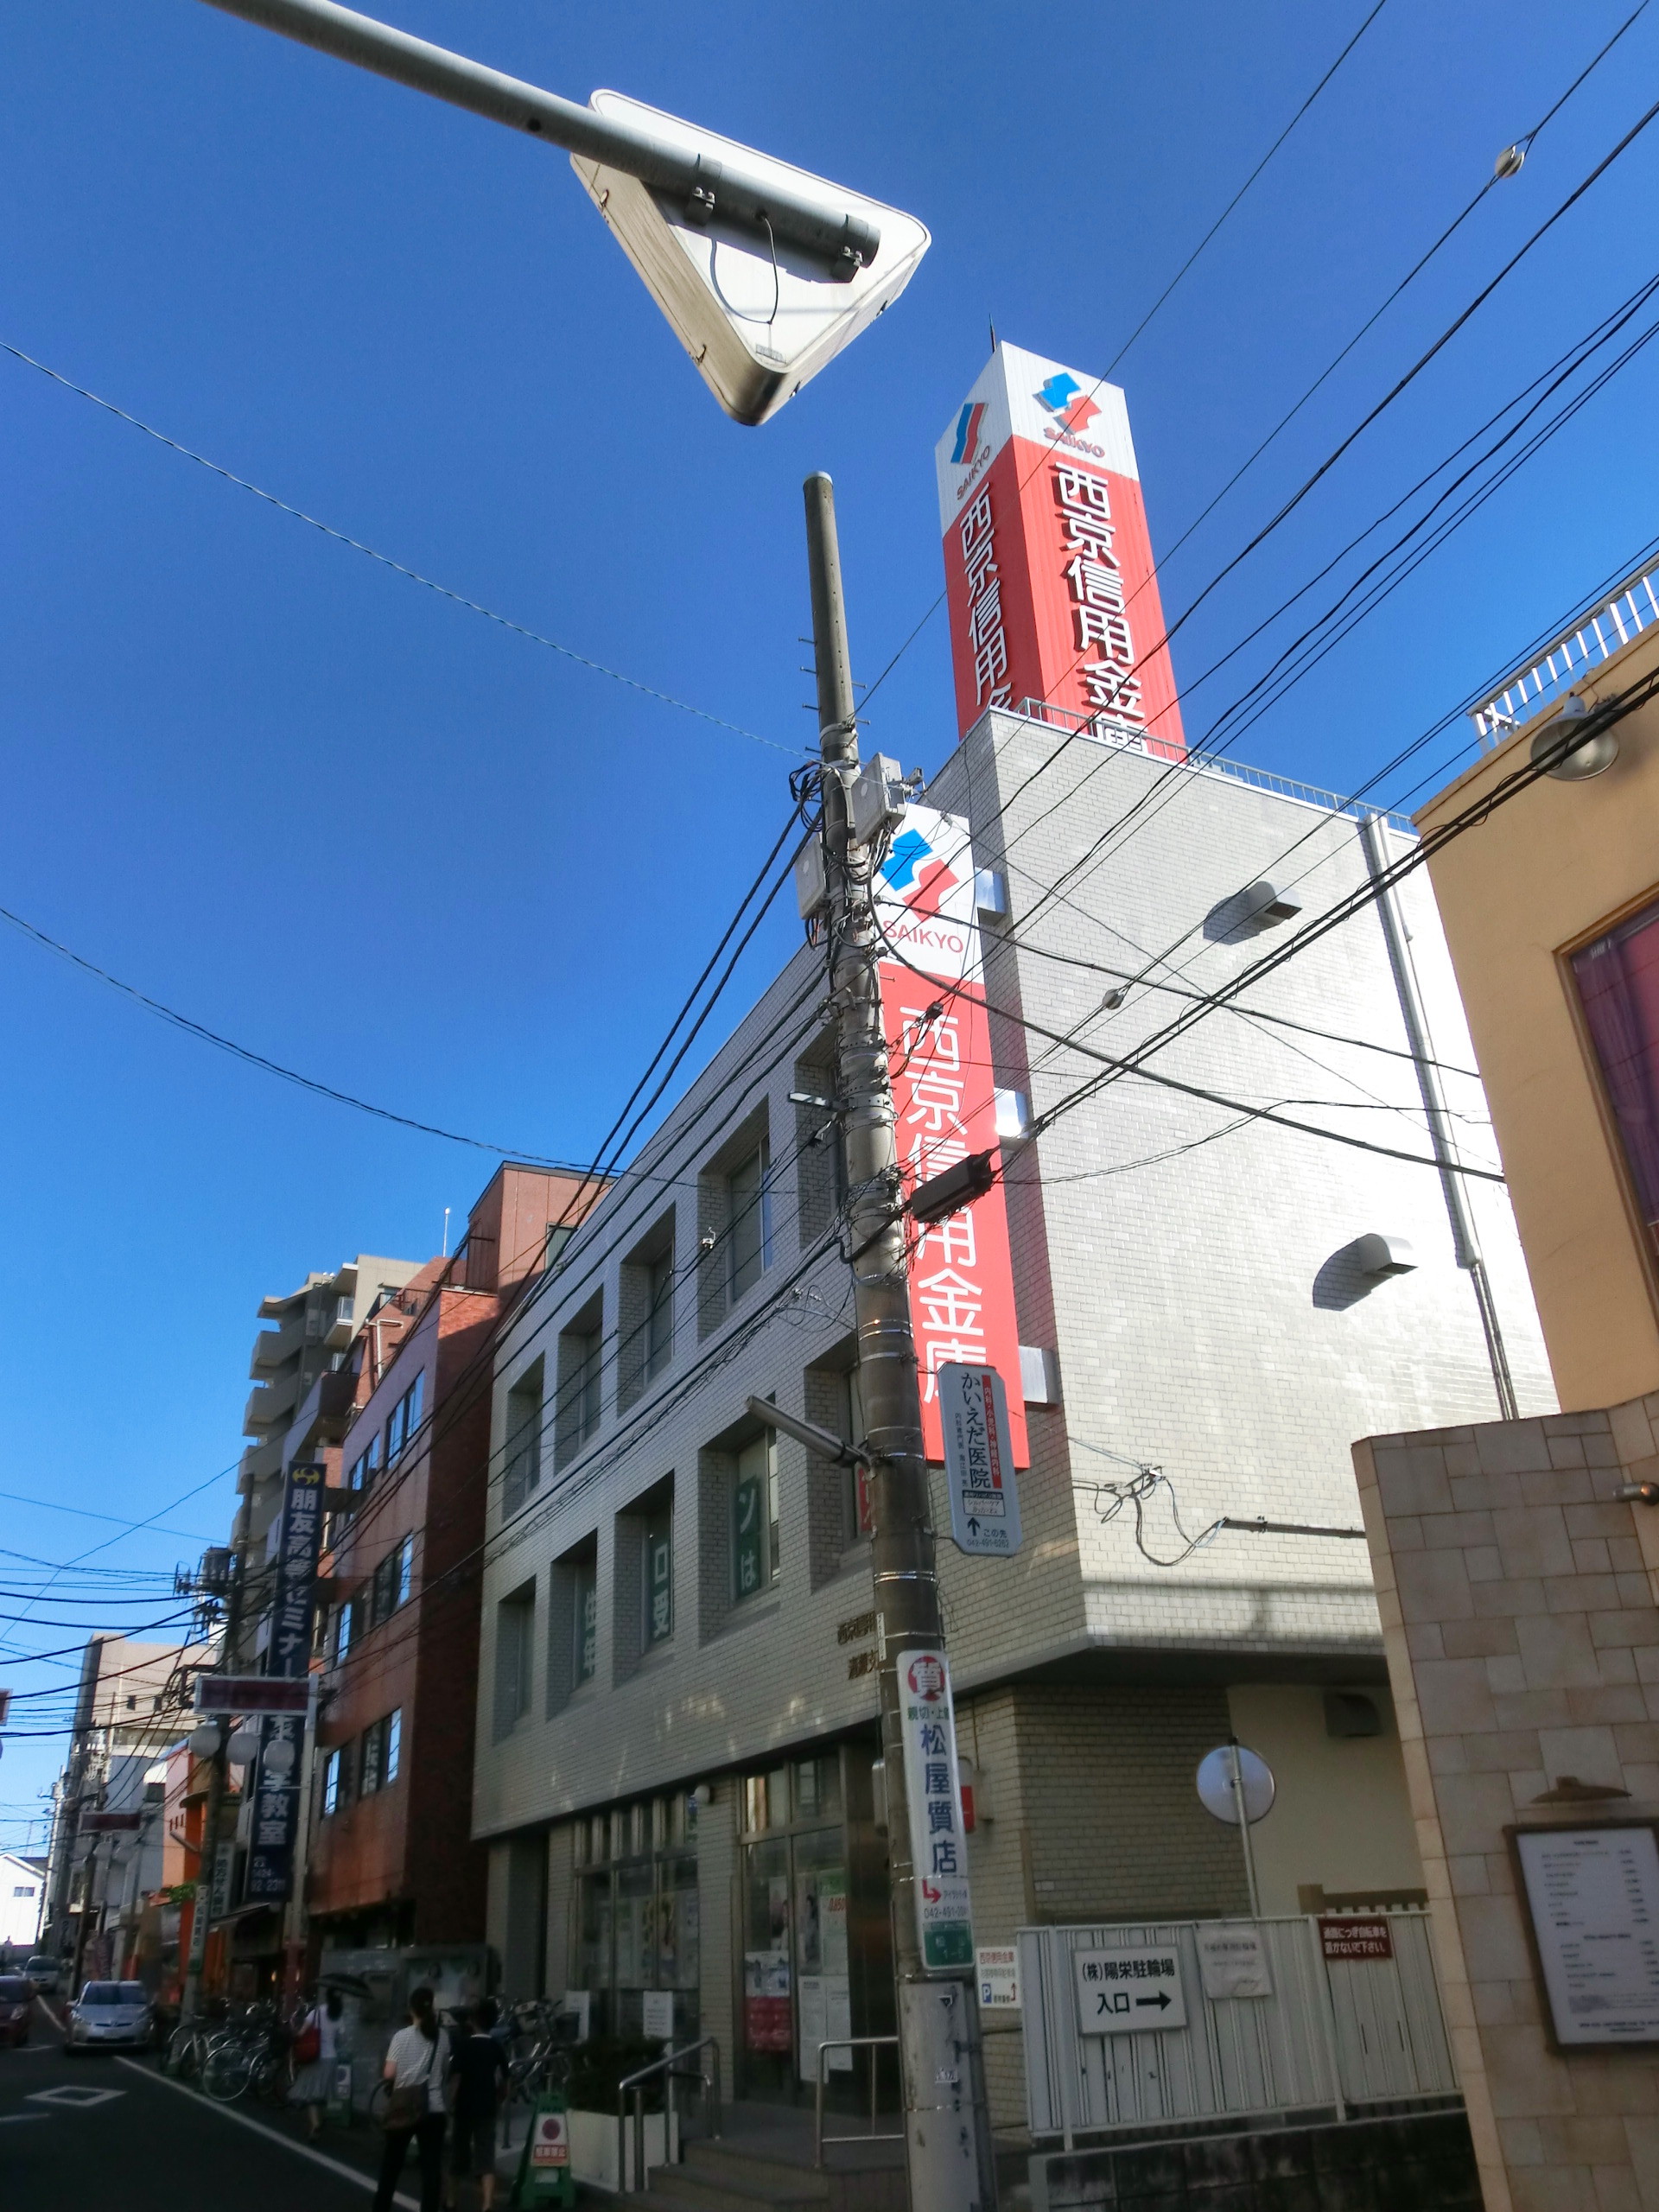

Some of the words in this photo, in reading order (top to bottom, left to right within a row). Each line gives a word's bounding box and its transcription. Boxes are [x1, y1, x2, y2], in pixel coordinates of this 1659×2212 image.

[1043, 427, 1105, 459] SAIKYO
[957, 445, 992, 500] SAIKYO
[882, 919, 964, 954] SAIKYO
[961, 1372, 991, 1489] かいえだ医院
[982, 1985, 991, 2001] P
[1096, 1993, 1131, 2015] 入口
